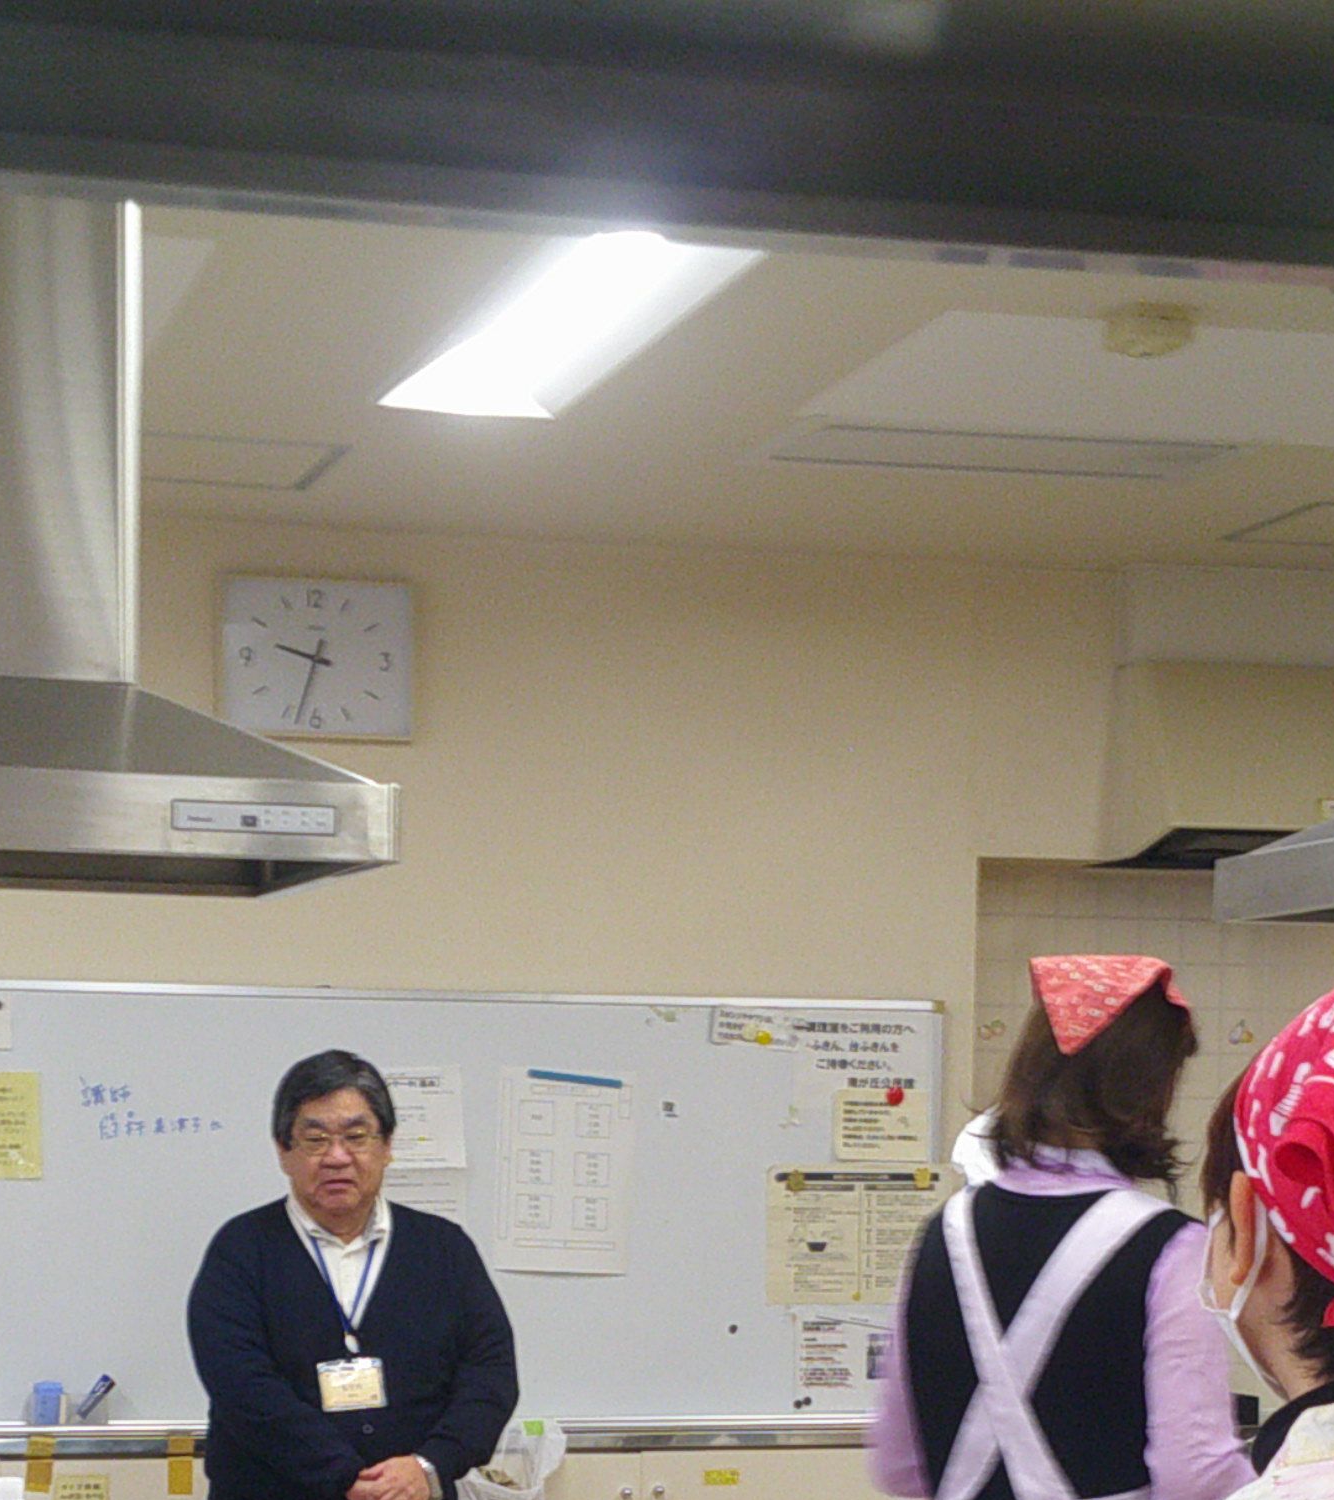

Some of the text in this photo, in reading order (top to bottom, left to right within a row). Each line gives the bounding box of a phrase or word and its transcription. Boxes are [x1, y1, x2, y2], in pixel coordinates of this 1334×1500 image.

[306, 589, 323, 608] 12
[238, 645, 253, 667] 9
[378, 651, 392, 672] 3
[308, 707, 323, 730] 6
